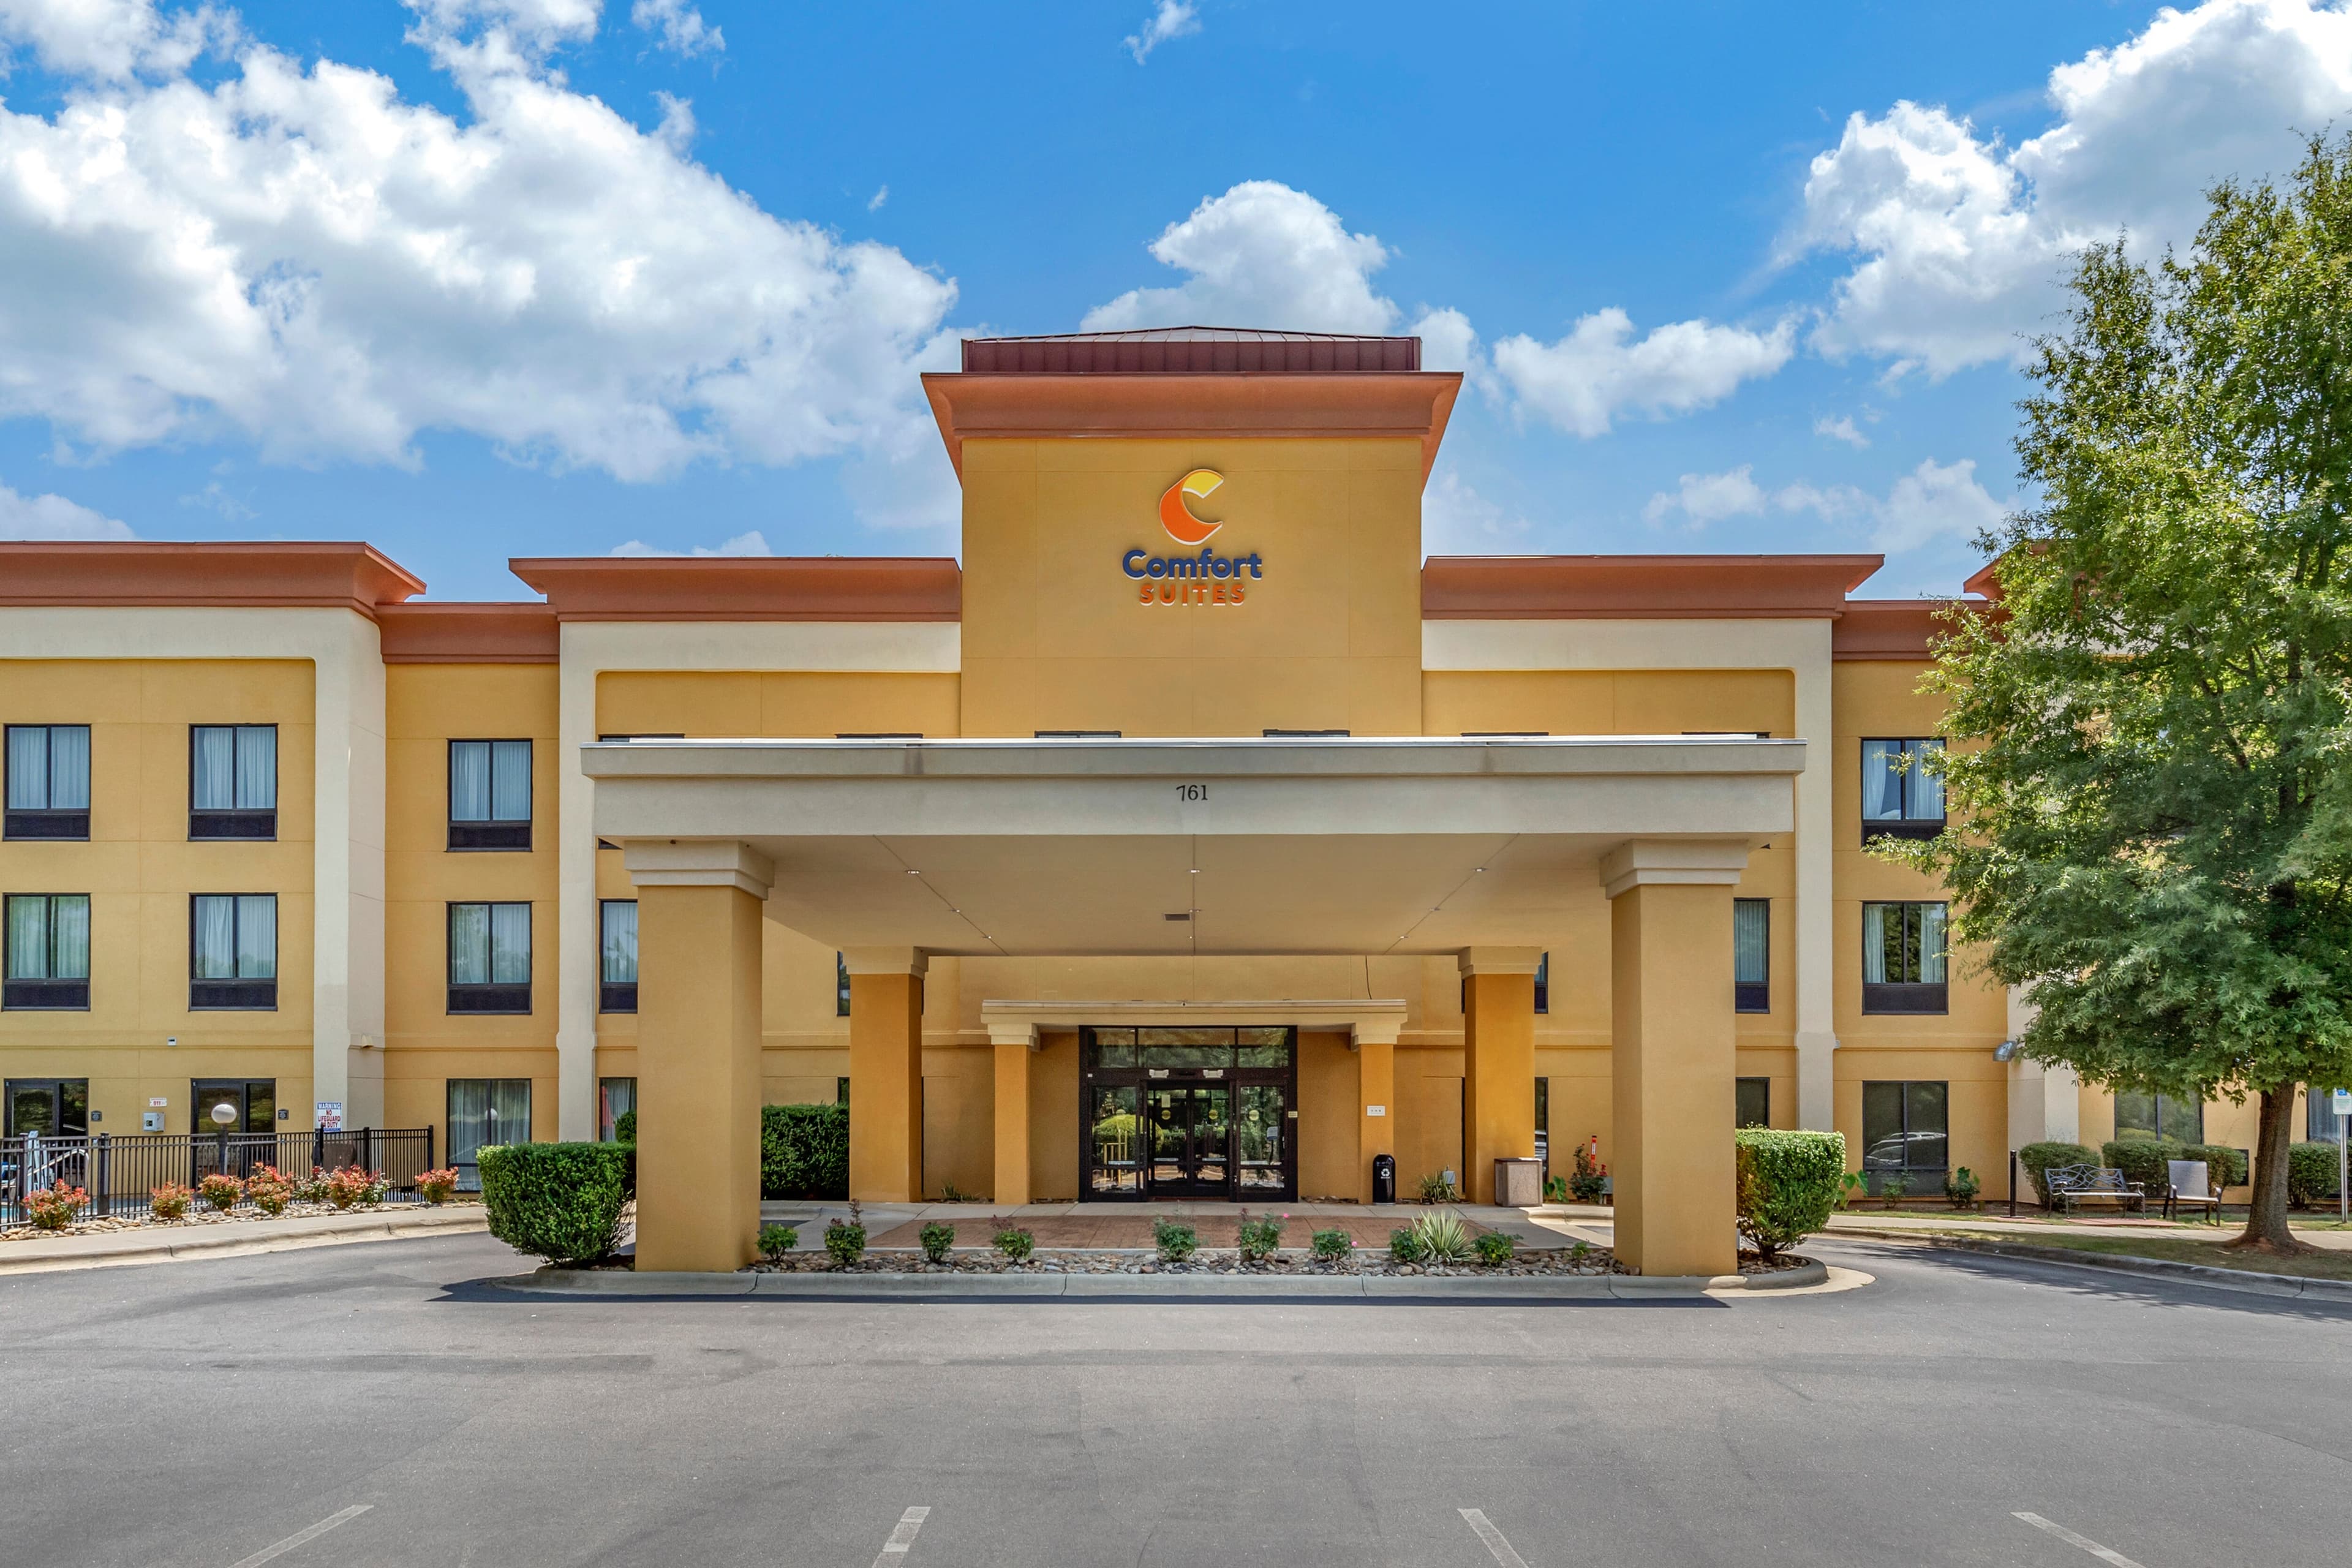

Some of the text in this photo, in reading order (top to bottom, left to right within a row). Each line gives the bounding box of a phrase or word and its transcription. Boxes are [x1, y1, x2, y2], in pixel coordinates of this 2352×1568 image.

[1122, 549, 1262, 580] Comfort
[1140, 584, 1245, 606] SUITES
[1176, 785, 1208, 801] 761
